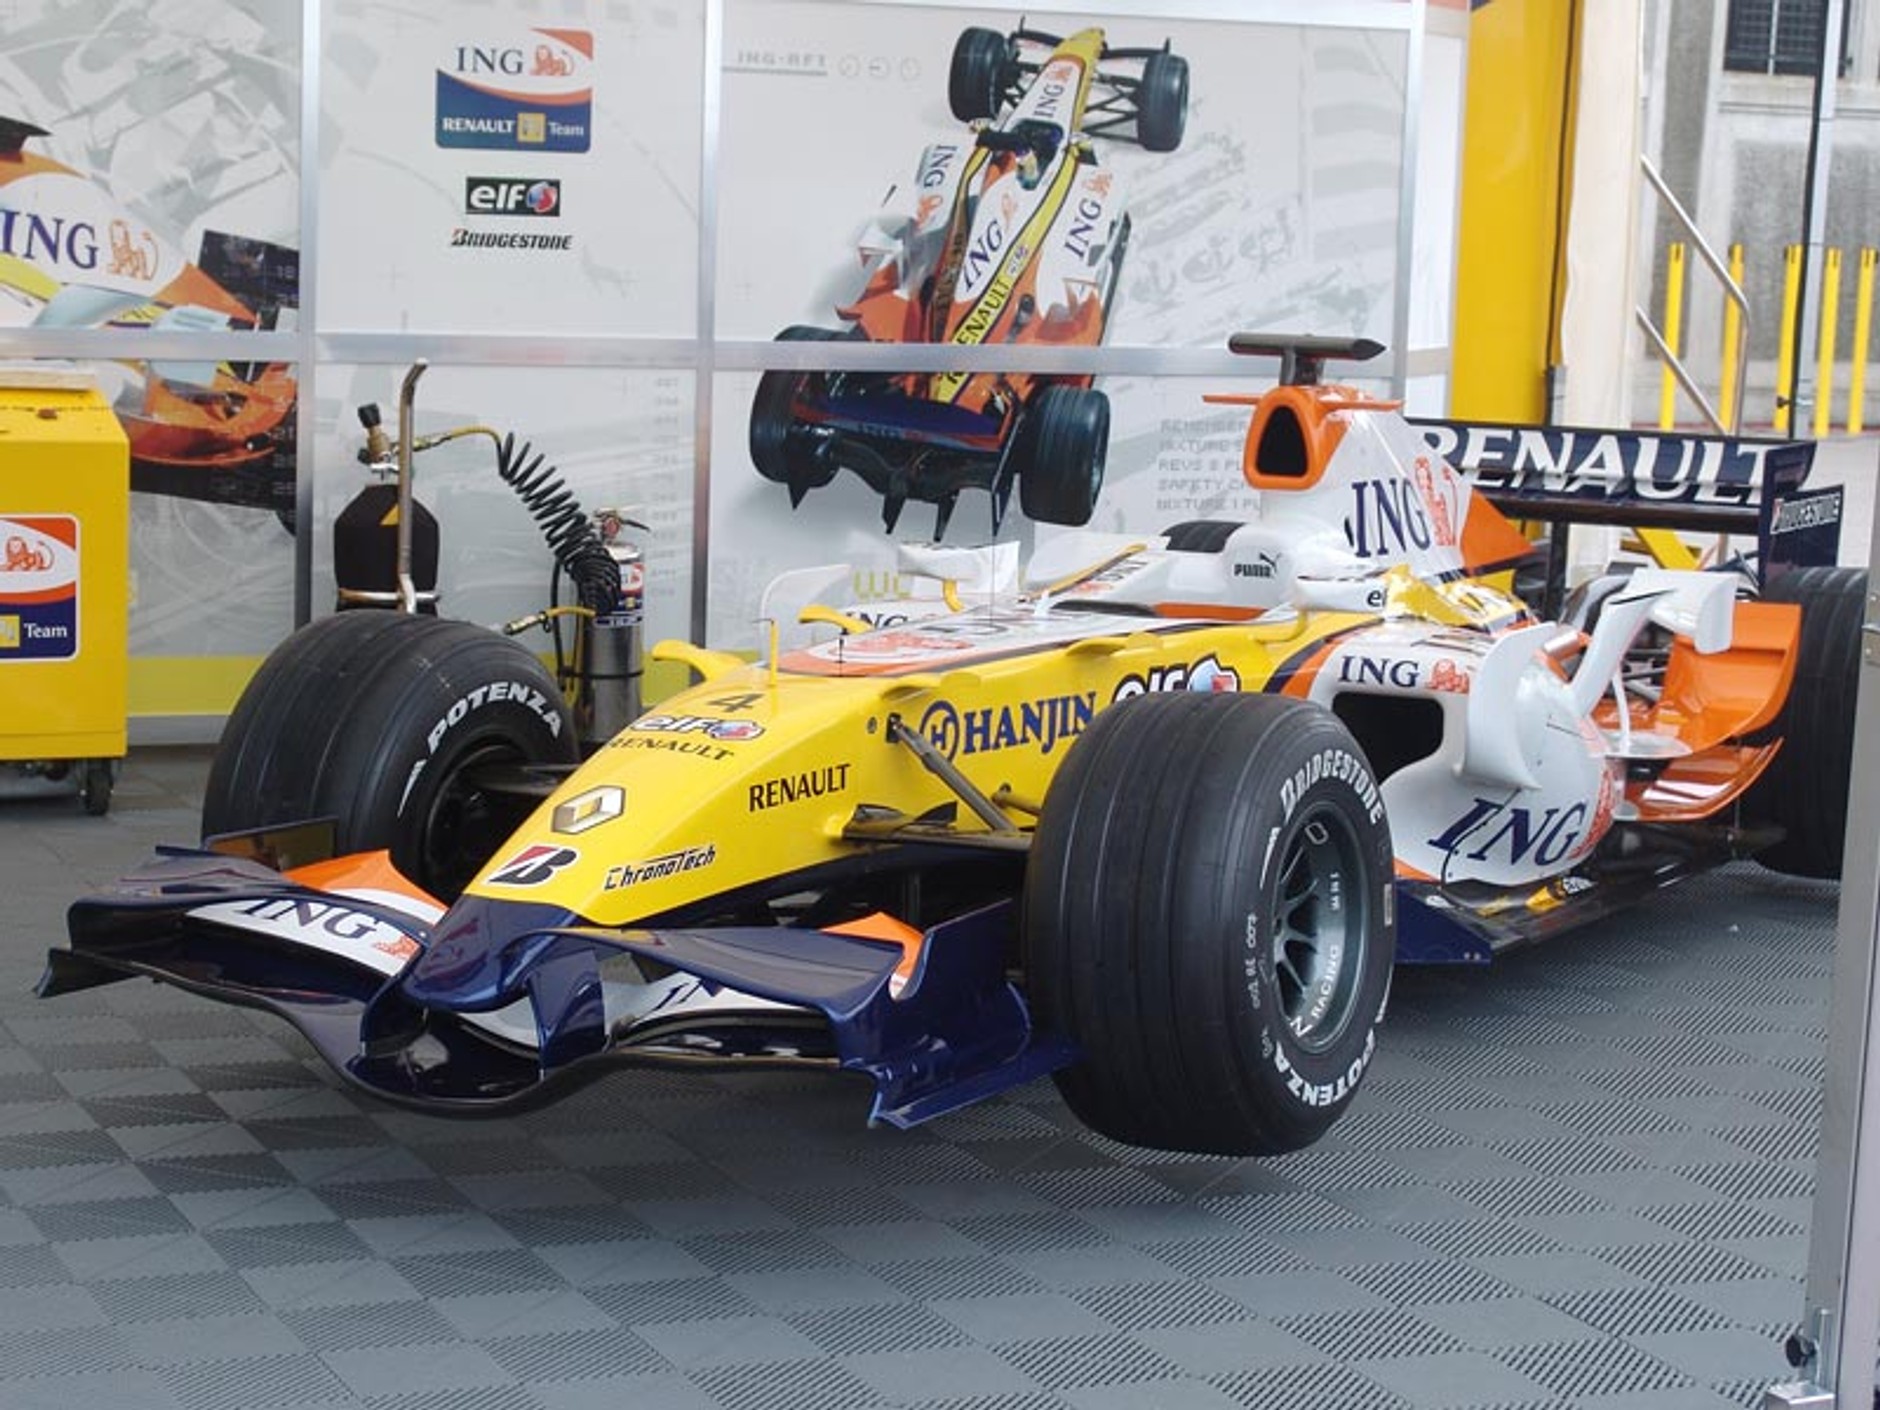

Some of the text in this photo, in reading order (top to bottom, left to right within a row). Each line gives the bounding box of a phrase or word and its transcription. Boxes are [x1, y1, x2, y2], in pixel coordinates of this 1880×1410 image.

[456, 46, 524, 75] ING
[1033, 84, 1064, 118] ING
[442, 116, 584, 136] RENAULT Team
[924, 144, 958, 189] ING
[469, 183, 526, 210] elf
[0, 208, 99, 270] ING
[451, 227, 573, 250] BRIDGESTONE
[1063, 198, 1104, 260] ING
[962, 220, 1004, 292] ING
[1352, 478, 1431, 558] ING
[1233, 563, 1271, 578] PUMA
[24, 622, 68, 639] Team
[1338, 655, 1421, 688] ING
[427, 682, 562, 755] POTENZA
[631, 715, 718, 734] elf
[705, 693, 764, 713] 4
[964, 691, 1096, 755] HANJIN
[749, 763, 851, 812] RENAULT
[1281, 749, 1383, 825] BRIDGESTONE
[1427, 797, 1588, 866] ING
[603, 843, 717, 892] ChronoTech
[236, 898, 378, 939] ING
[1311, 944, 1340, 1020] RACING
[1274, 1027, 1376, 1107] POTENZA
